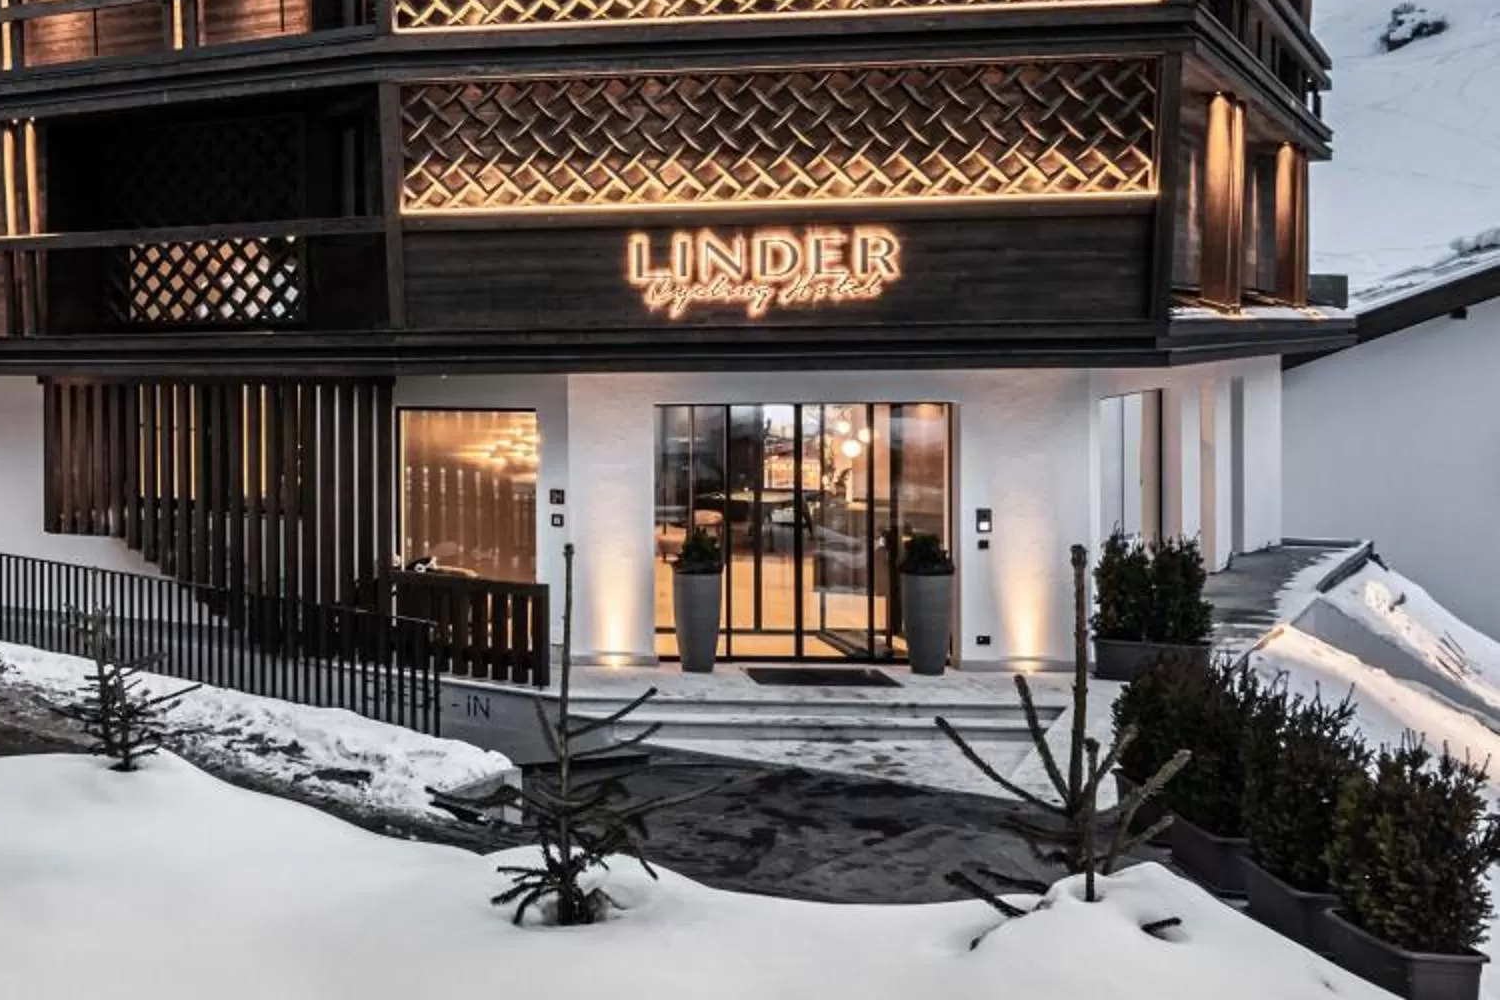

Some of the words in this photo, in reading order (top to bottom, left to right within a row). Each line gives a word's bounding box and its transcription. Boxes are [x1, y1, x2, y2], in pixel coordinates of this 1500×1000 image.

[630, 232, 899, 281] LINDER
[780, 270, 884, 303] Hotel
[467, 694, 491, 719] IN
